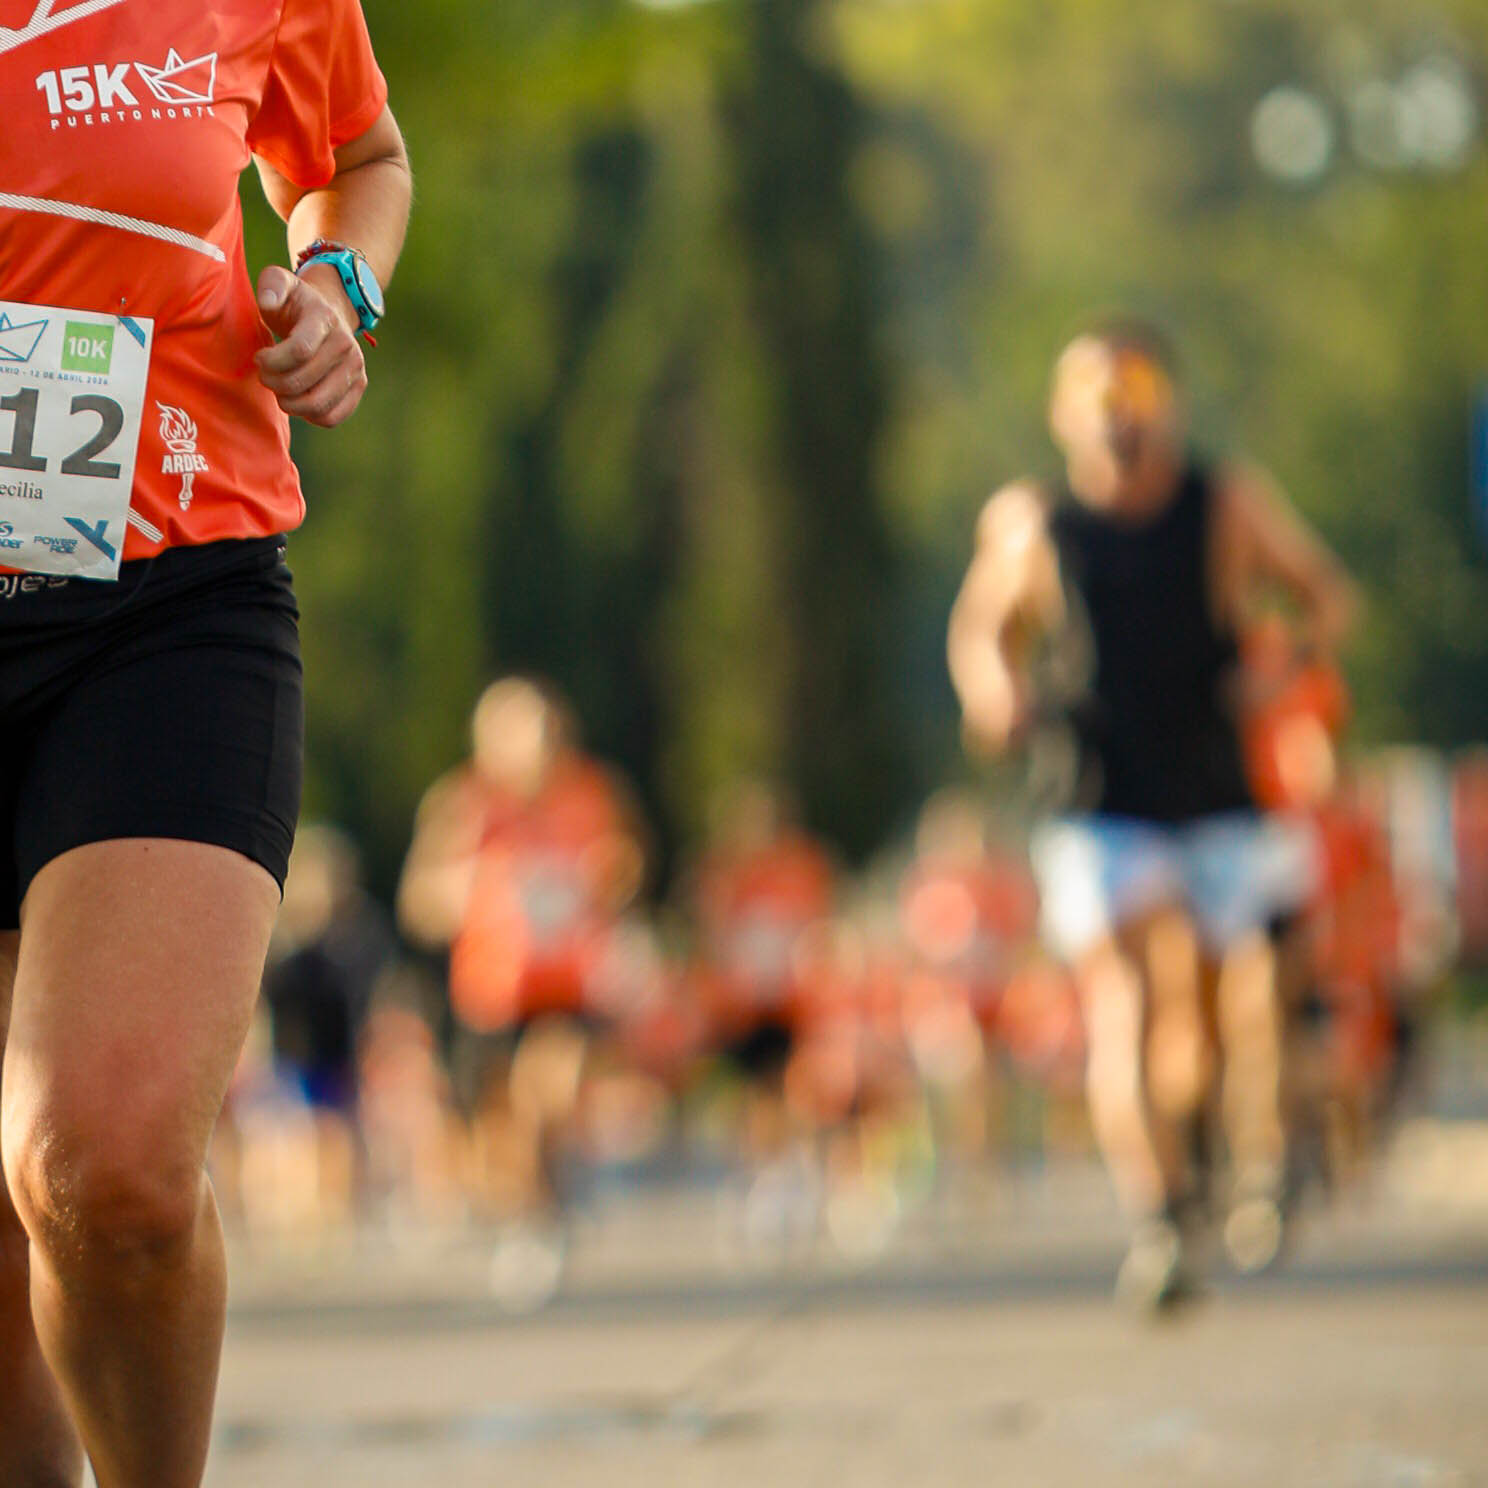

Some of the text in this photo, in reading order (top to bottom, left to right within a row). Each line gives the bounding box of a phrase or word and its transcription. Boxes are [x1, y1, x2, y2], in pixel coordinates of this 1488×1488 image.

[35, 64, 139, 114] 15K
[50, 110, 142, 130] PUERTO
[68, 336, 108, 360] 10K
[58, 373, 83, 383] ABRIL
[33, 535, 78, 548] POWER
